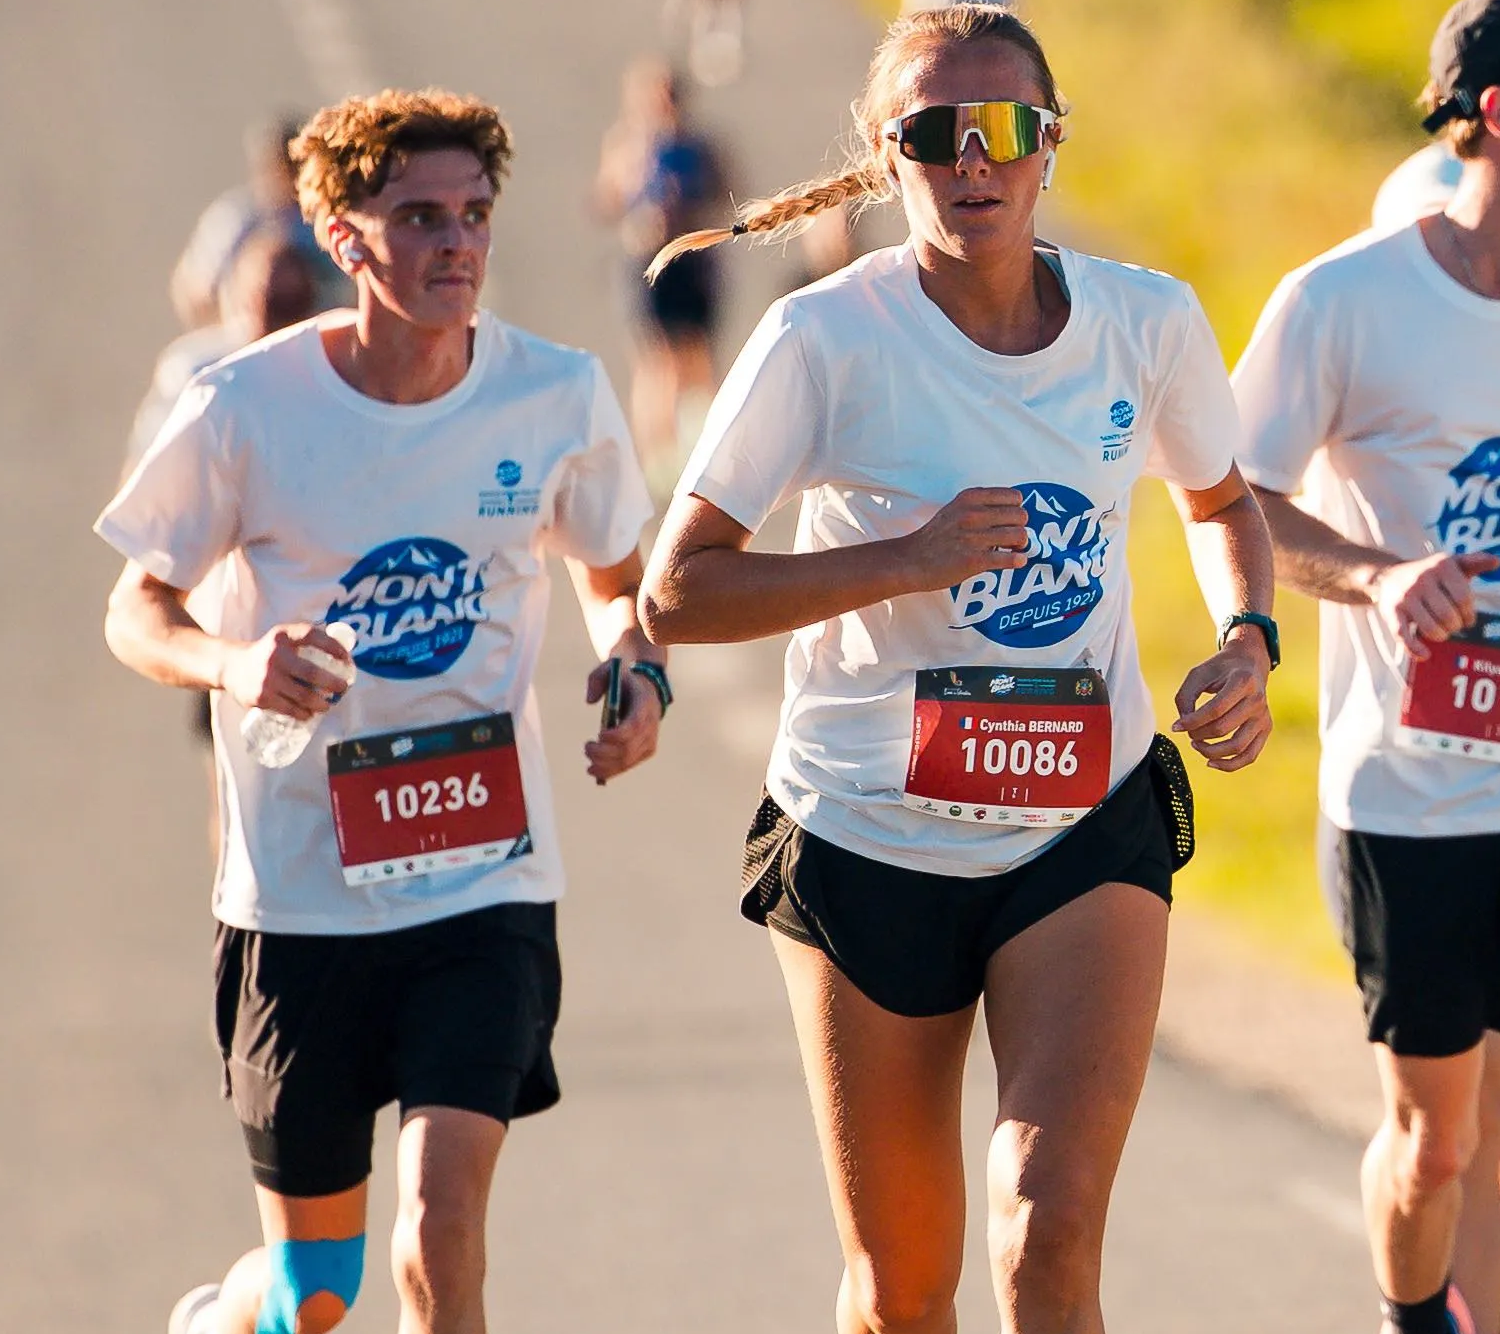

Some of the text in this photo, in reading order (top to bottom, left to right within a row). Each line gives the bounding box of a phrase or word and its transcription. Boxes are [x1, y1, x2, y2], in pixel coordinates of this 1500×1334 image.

[1025, 505, 1114, 559] ONT
[336, 557, 490, 611] MONT
[950, 534, 1109, 627] BLANC
[999, 590, 1097, 629] DEPUIS 1921
[979, 718, 1084, 733] Cynthia BERNARD
[961, 737, 1078, 777] 10086
[374, 772, 489, 822] 10236
